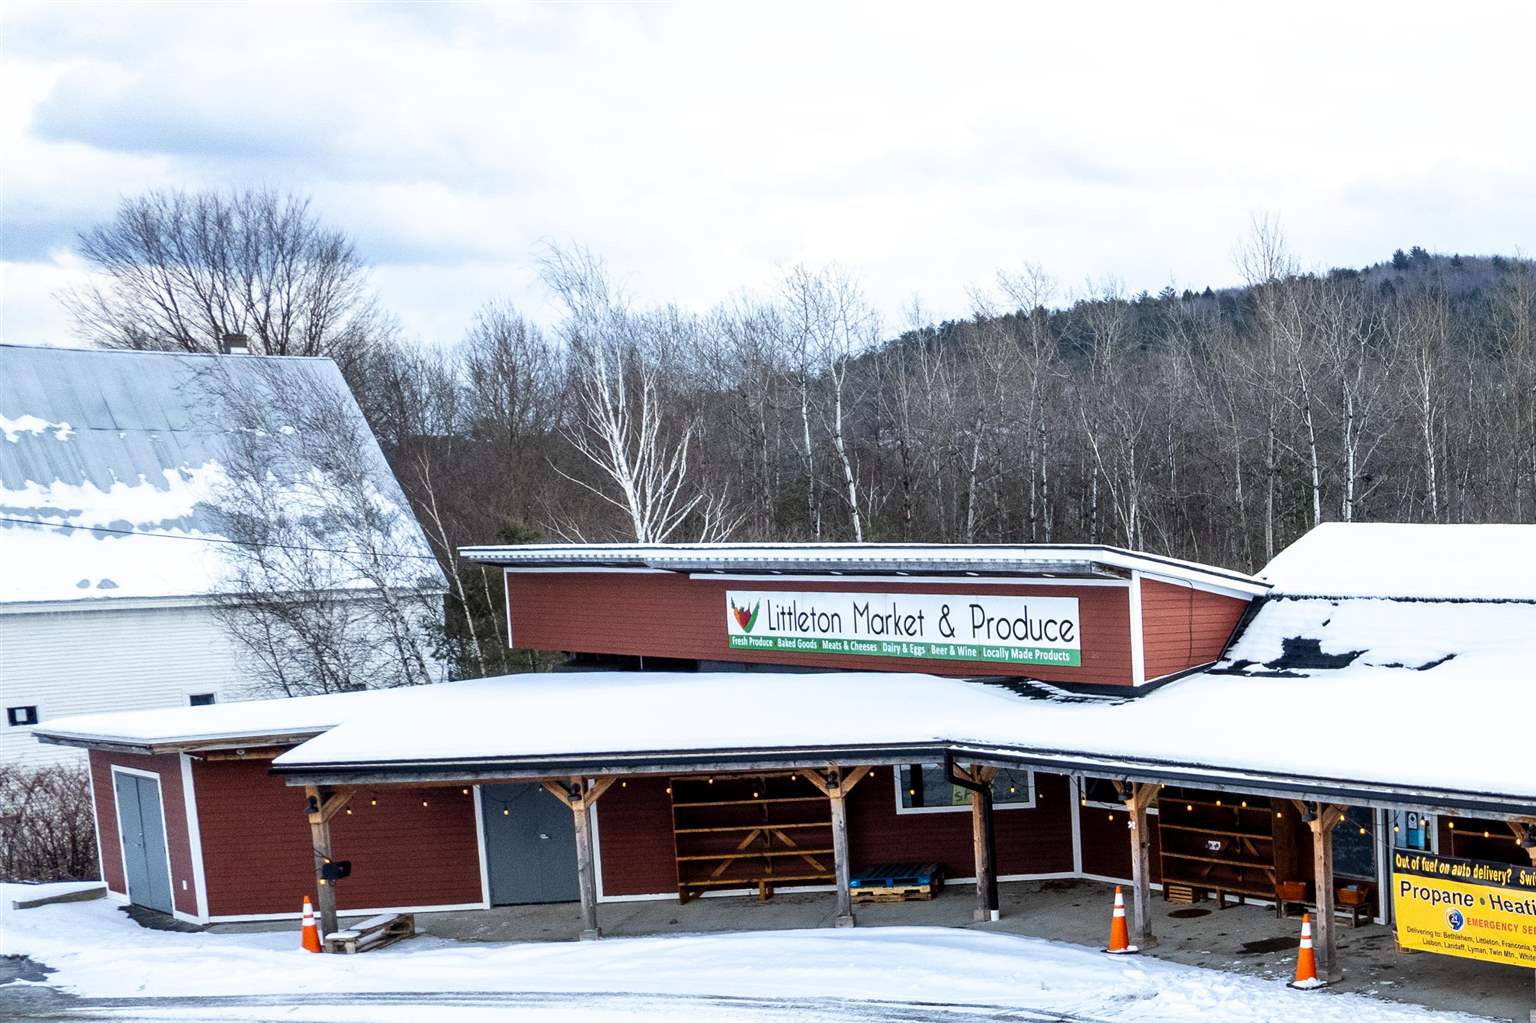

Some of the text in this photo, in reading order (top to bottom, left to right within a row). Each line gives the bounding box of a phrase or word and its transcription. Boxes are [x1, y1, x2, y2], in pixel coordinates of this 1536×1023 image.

[767, 599, 1075, 643] Littleton Market & Produce
[732, 637, 1070, 661] Fresh Produce Baked Goods Meats & Cheeses Dairy & Eggs Beer & Wine Locally Made Products
[1395, 853, 1410, 869] Out
[1411, 858, 1420, 870] of
[1421, 857, 1438, 872] fuel
[1439, 862, 1450, 873] on
[1451, 861, 1471, 878] auto
[1473, 863, 1512, 886] delivery?
[1400, 880, 1474, 907] Propane
[1466, 917, 1519, 933] EMERGENCY
[1406, 926, 1434, 938] Delivering
[1443, 931, 1474, 943] Bethlehem,
[1475, 937, 1501, 947] Littleton,
[1501, 940, 1531, 951] Franconia,
[1422, 938, 1443, 948] Lisbon,
[1467, 946, 1488, 956] Lyman,
[1489, 949, 1503, 957] Twin
